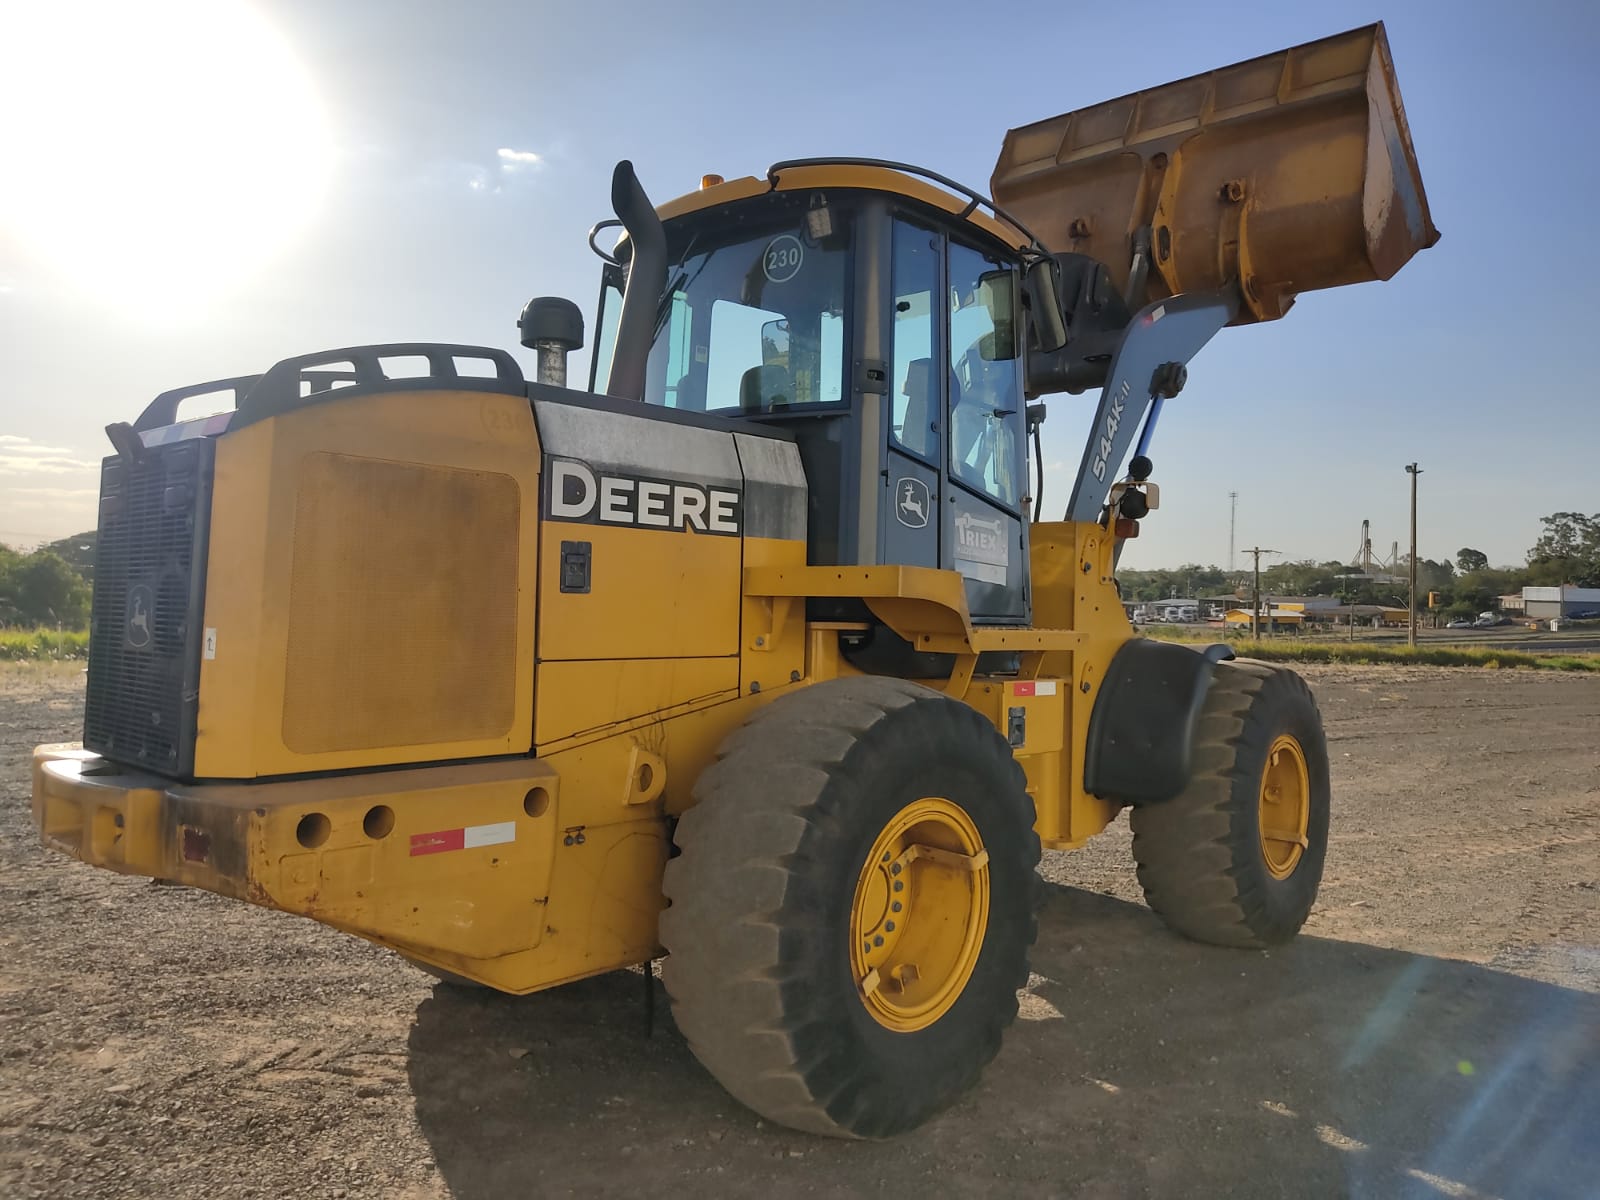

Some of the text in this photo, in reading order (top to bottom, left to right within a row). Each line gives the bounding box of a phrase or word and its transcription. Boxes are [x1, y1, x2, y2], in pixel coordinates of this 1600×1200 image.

[768, 248, 798, 270] 230
[551, 460, 739, 533] DEERE
[955, 517, 996, 551] TRIEX
